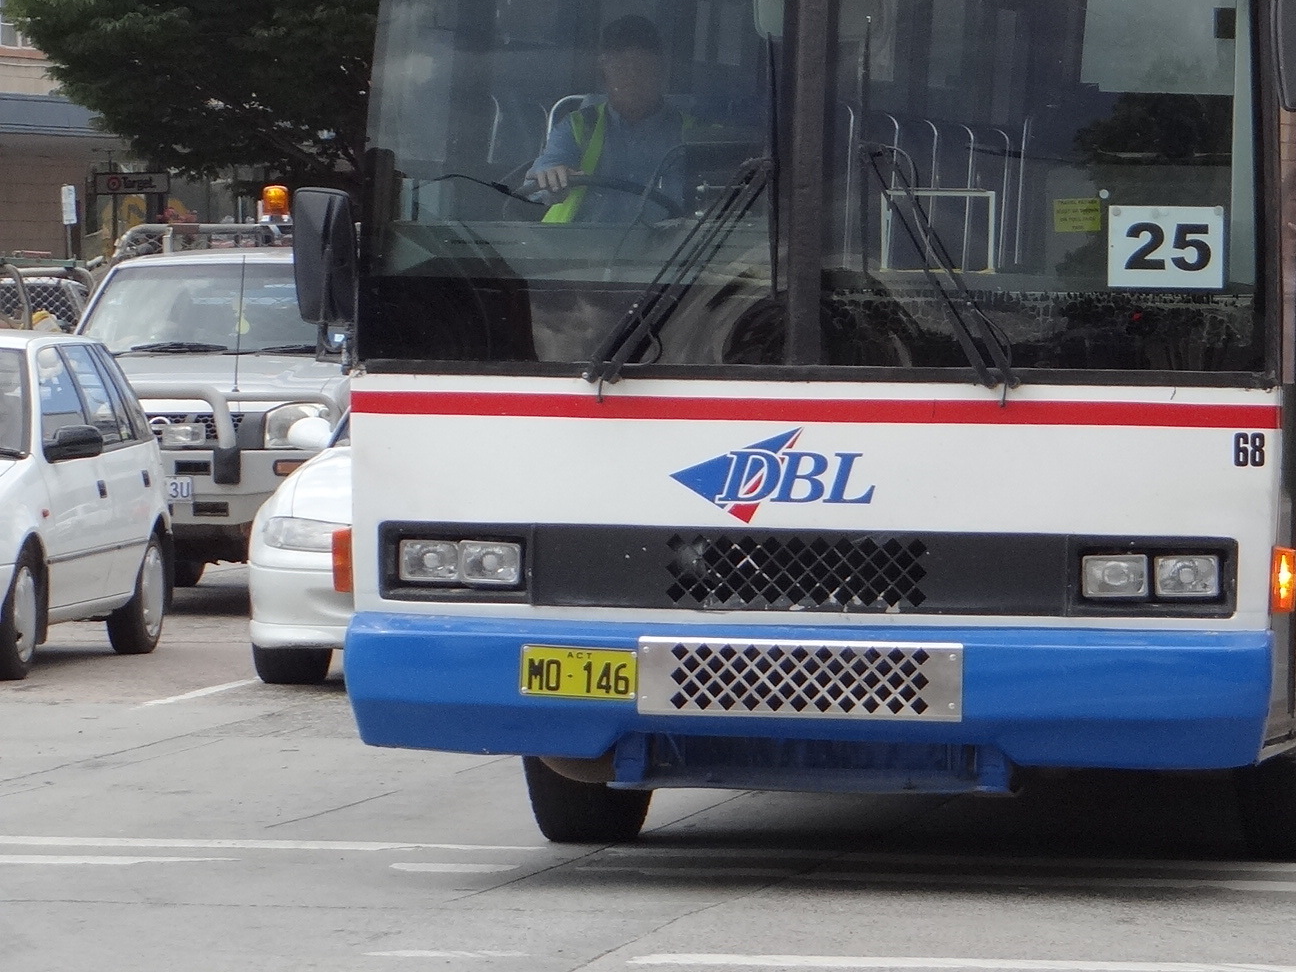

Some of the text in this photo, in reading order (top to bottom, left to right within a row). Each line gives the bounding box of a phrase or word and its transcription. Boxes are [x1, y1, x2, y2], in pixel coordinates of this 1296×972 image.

[1124, 222, 1212, 272] 25
[1234, 432, 1264, 467] 68
[716, 450, 876, 504] DBL
[567, 651, 592, 660] ACT
